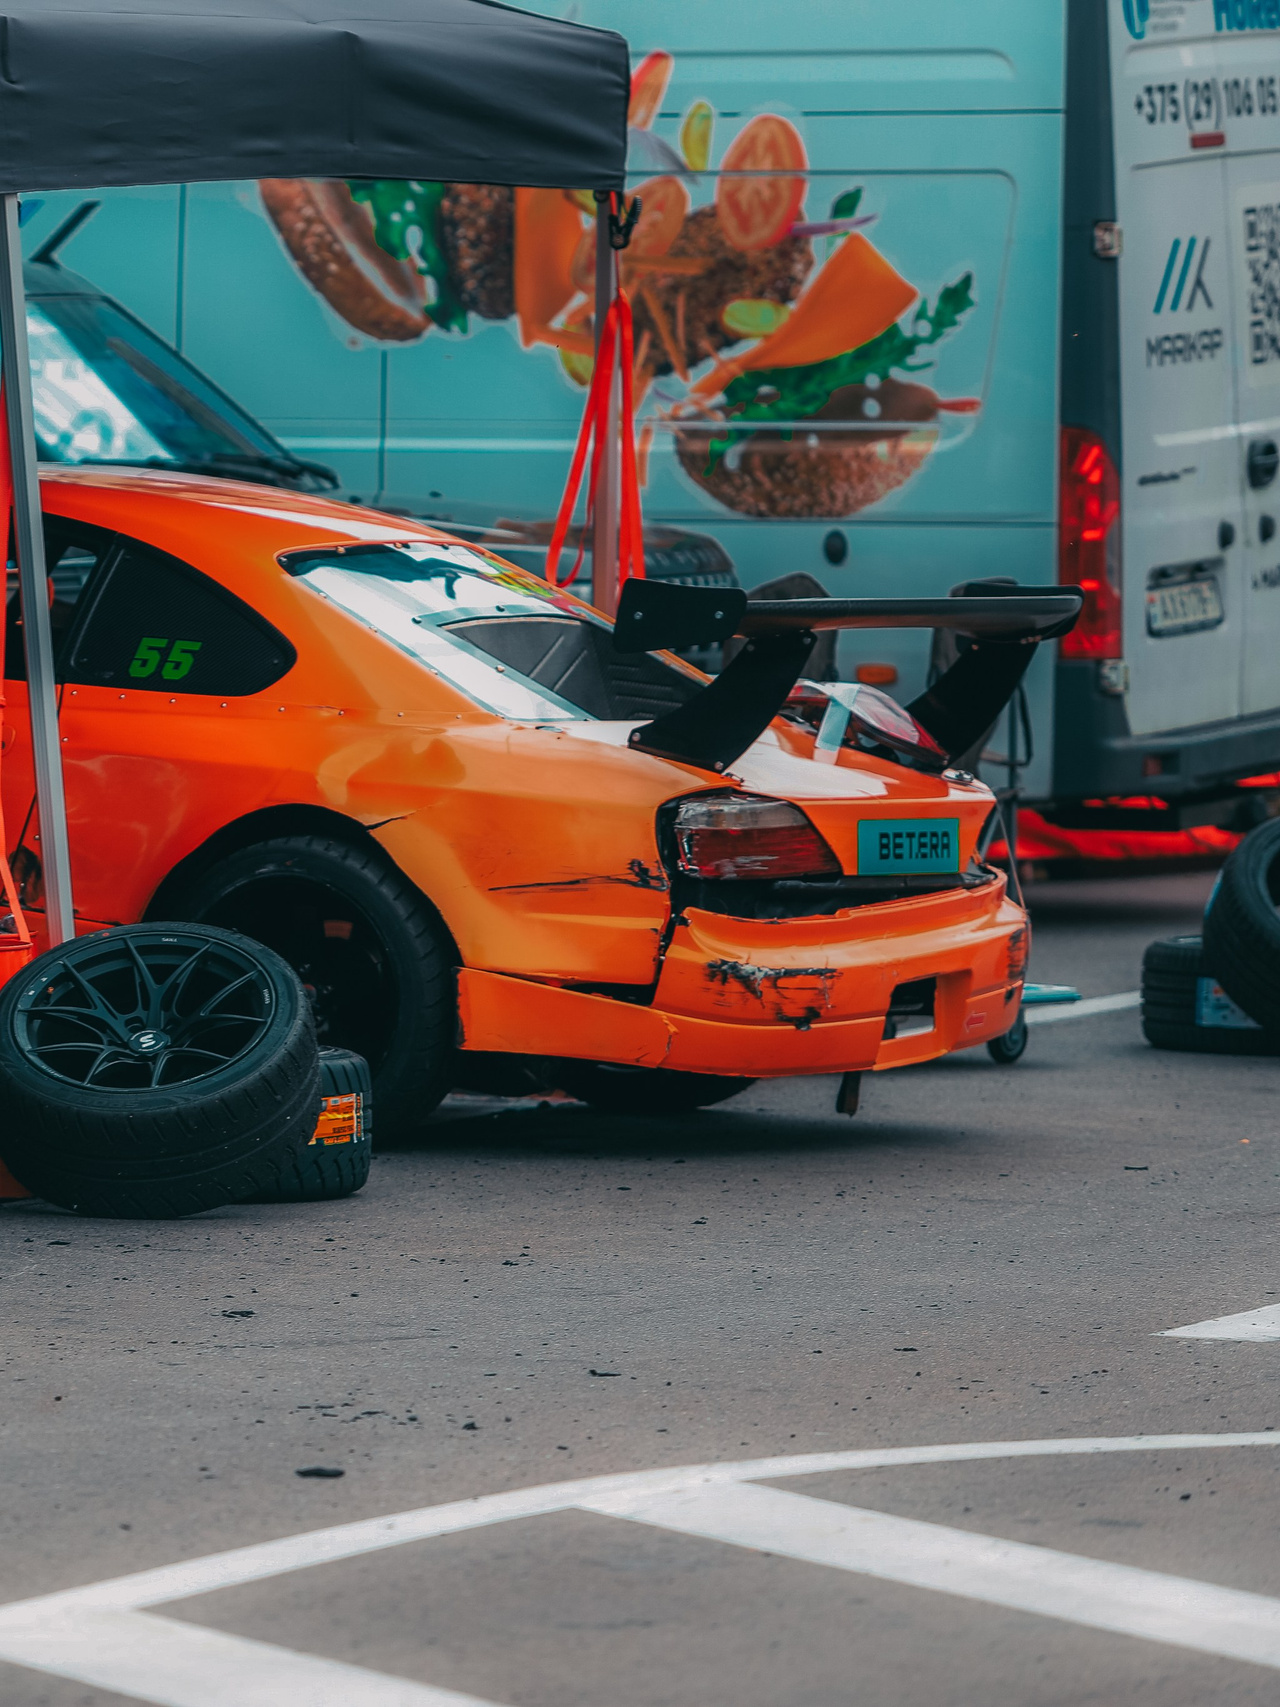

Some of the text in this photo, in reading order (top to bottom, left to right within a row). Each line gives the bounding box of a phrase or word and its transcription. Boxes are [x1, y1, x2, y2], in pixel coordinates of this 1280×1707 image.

[1135, 83, 1180, 125] +375
[1184, 78, 1222, 131] (29)
[128, 637, 203, 680] 55
[878, 830, 951, 860] BETERA
